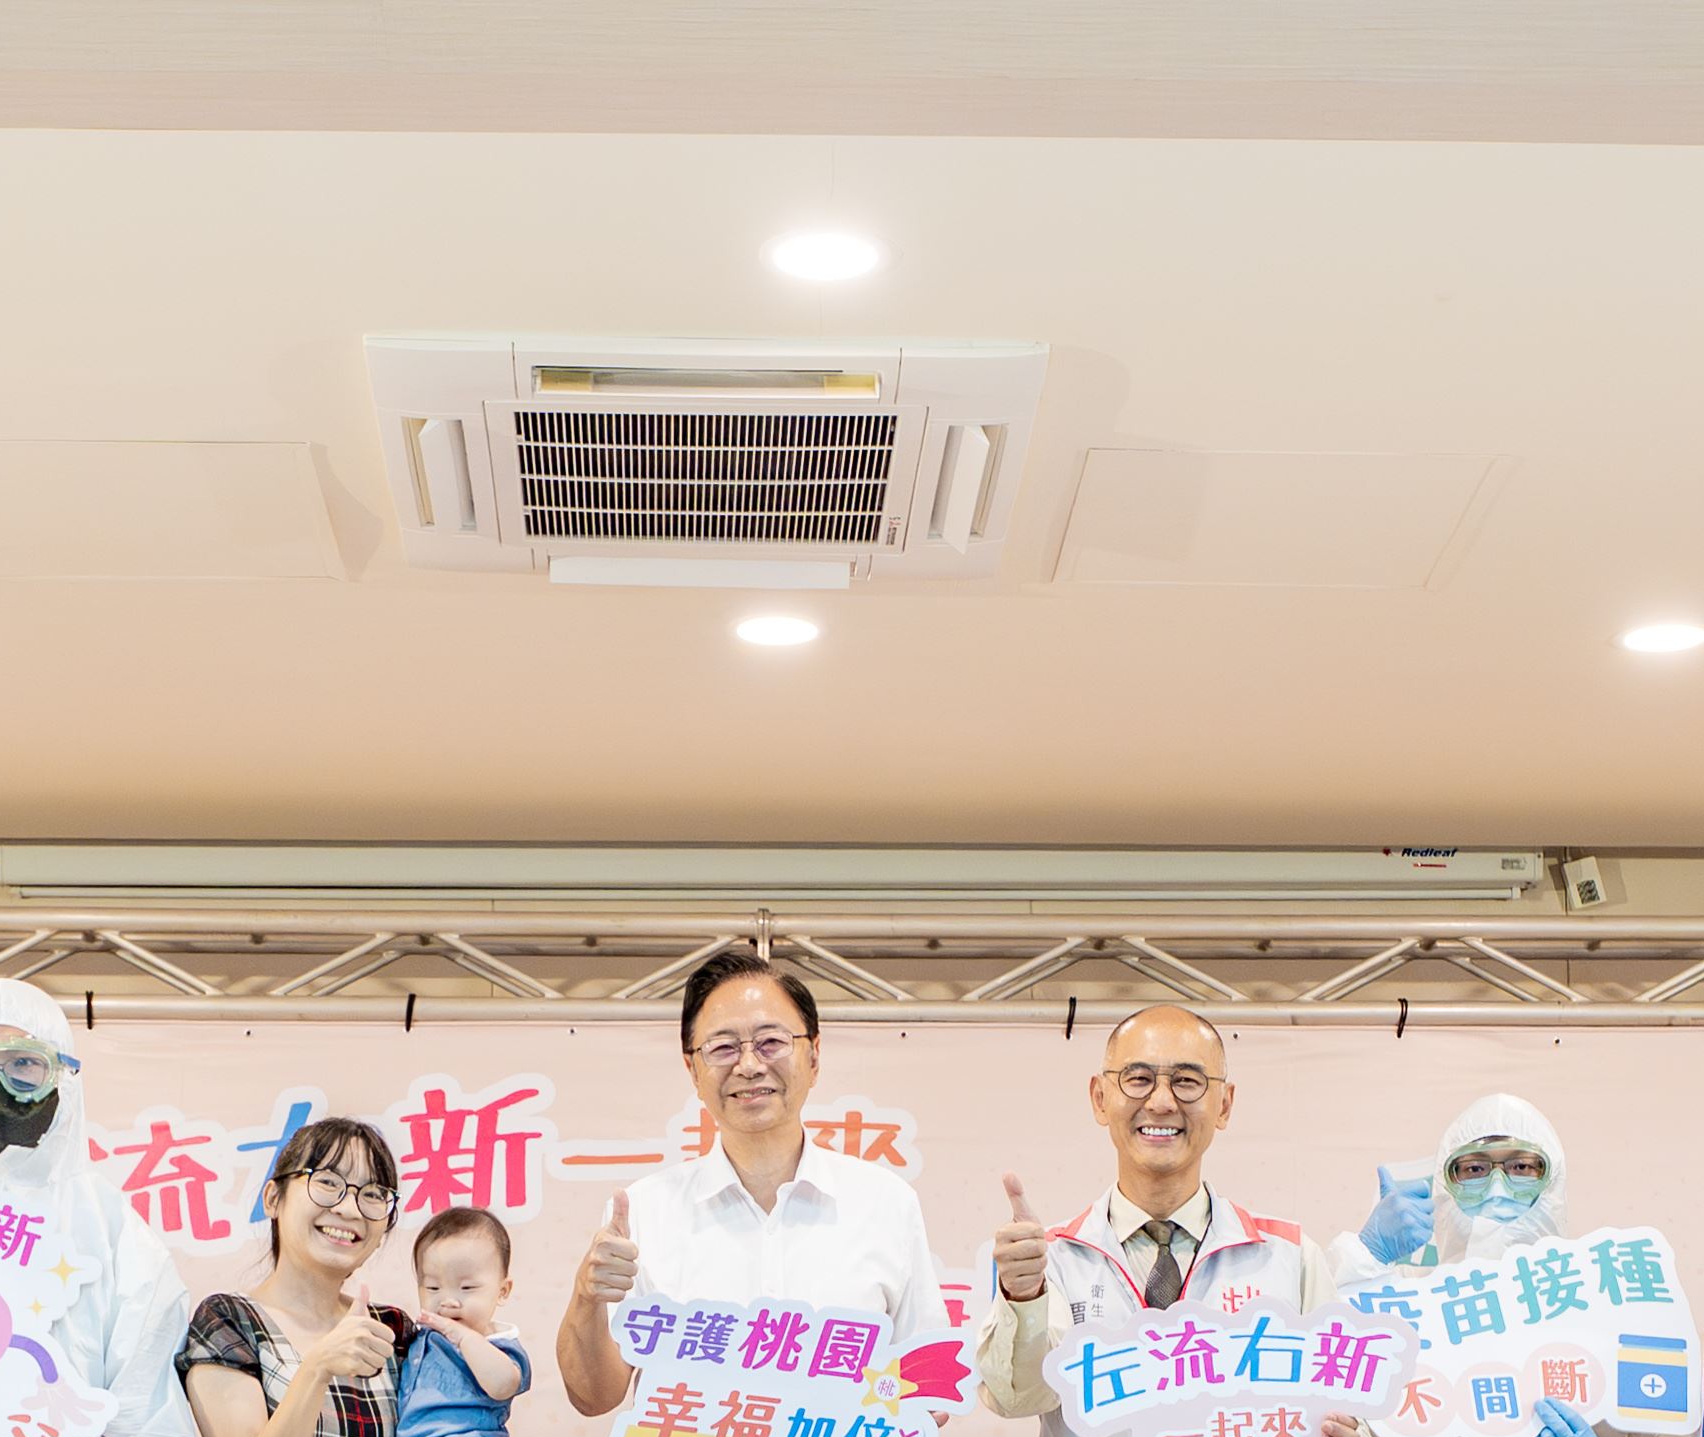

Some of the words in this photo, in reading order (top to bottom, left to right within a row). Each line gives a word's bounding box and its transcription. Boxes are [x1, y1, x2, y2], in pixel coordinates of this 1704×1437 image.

[1401, 848, 1458, 858] Redleaf
[623, 1304, 881, 1383] 守護桃園
[1064, 1316, 1393, 1414] 左流右新
[1397, 1357, 1590, 1425] 不間斷
